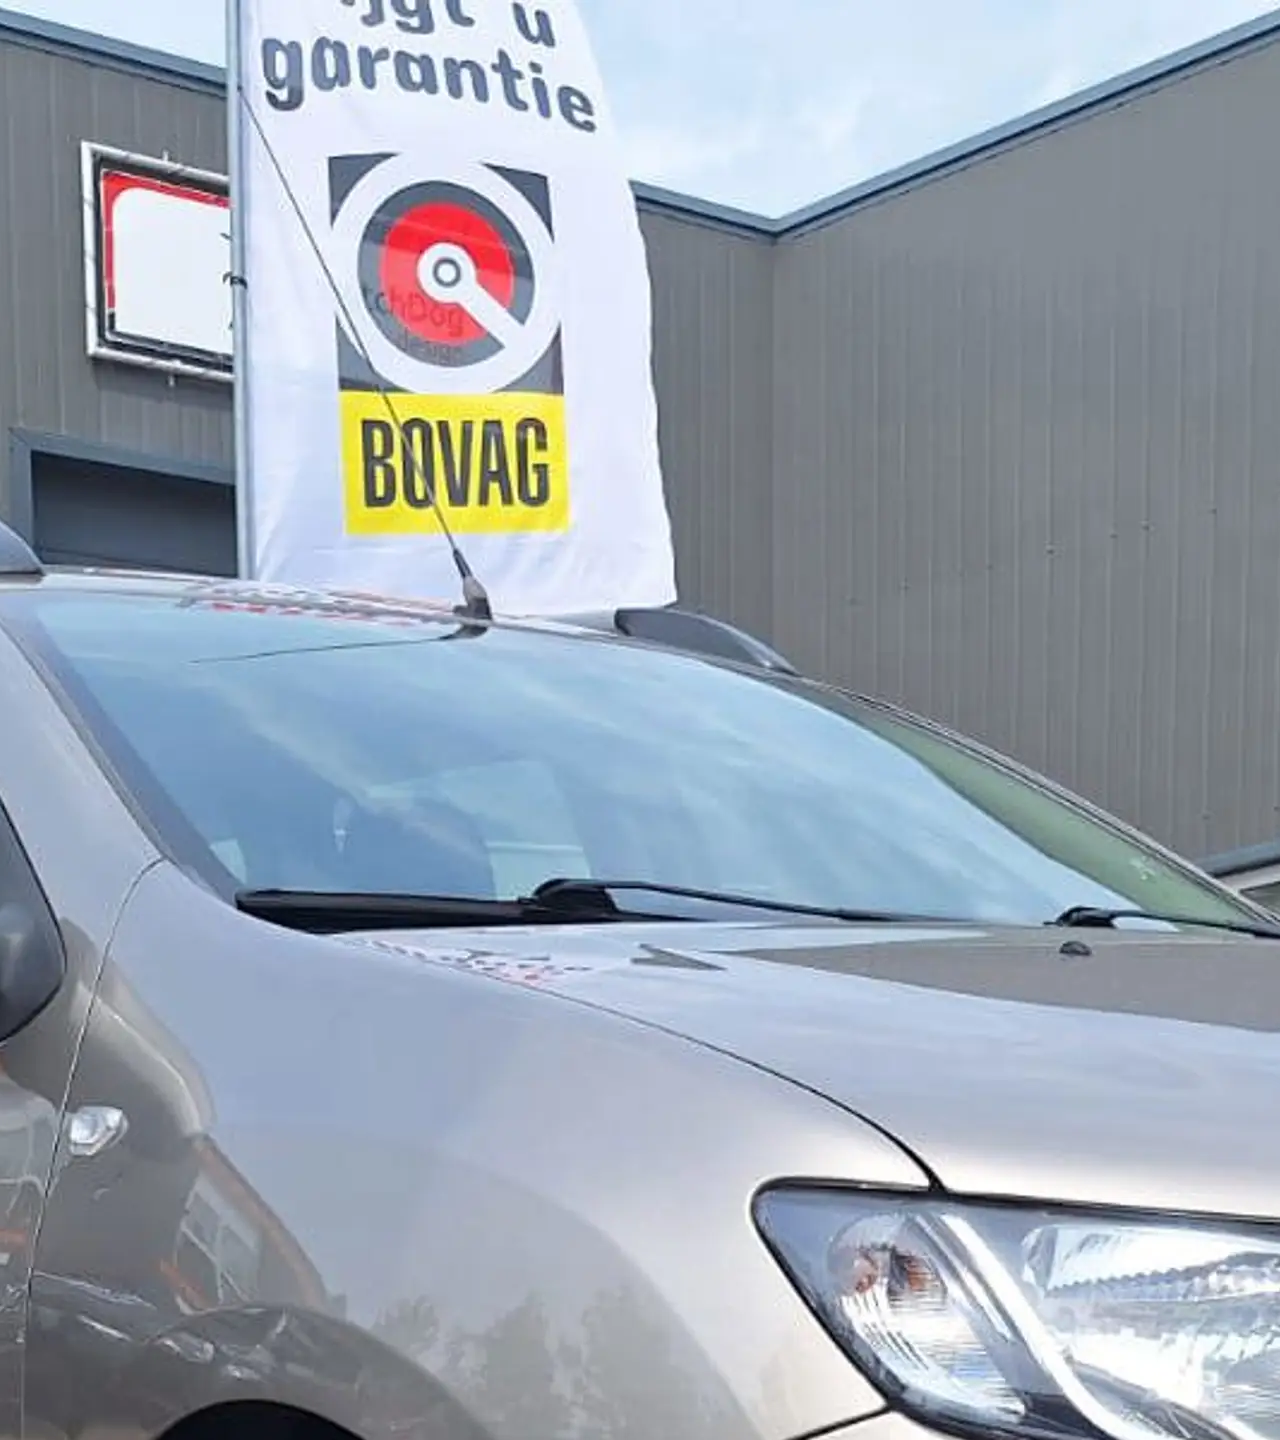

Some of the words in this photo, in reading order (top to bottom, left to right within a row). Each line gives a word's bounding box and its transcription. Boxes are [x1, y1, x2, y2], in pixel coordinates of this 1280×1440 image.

[513, 2, 556, 48] u
[261, 36, 597, 133] garantie
[361, 416, 549, 508] BOVAG
